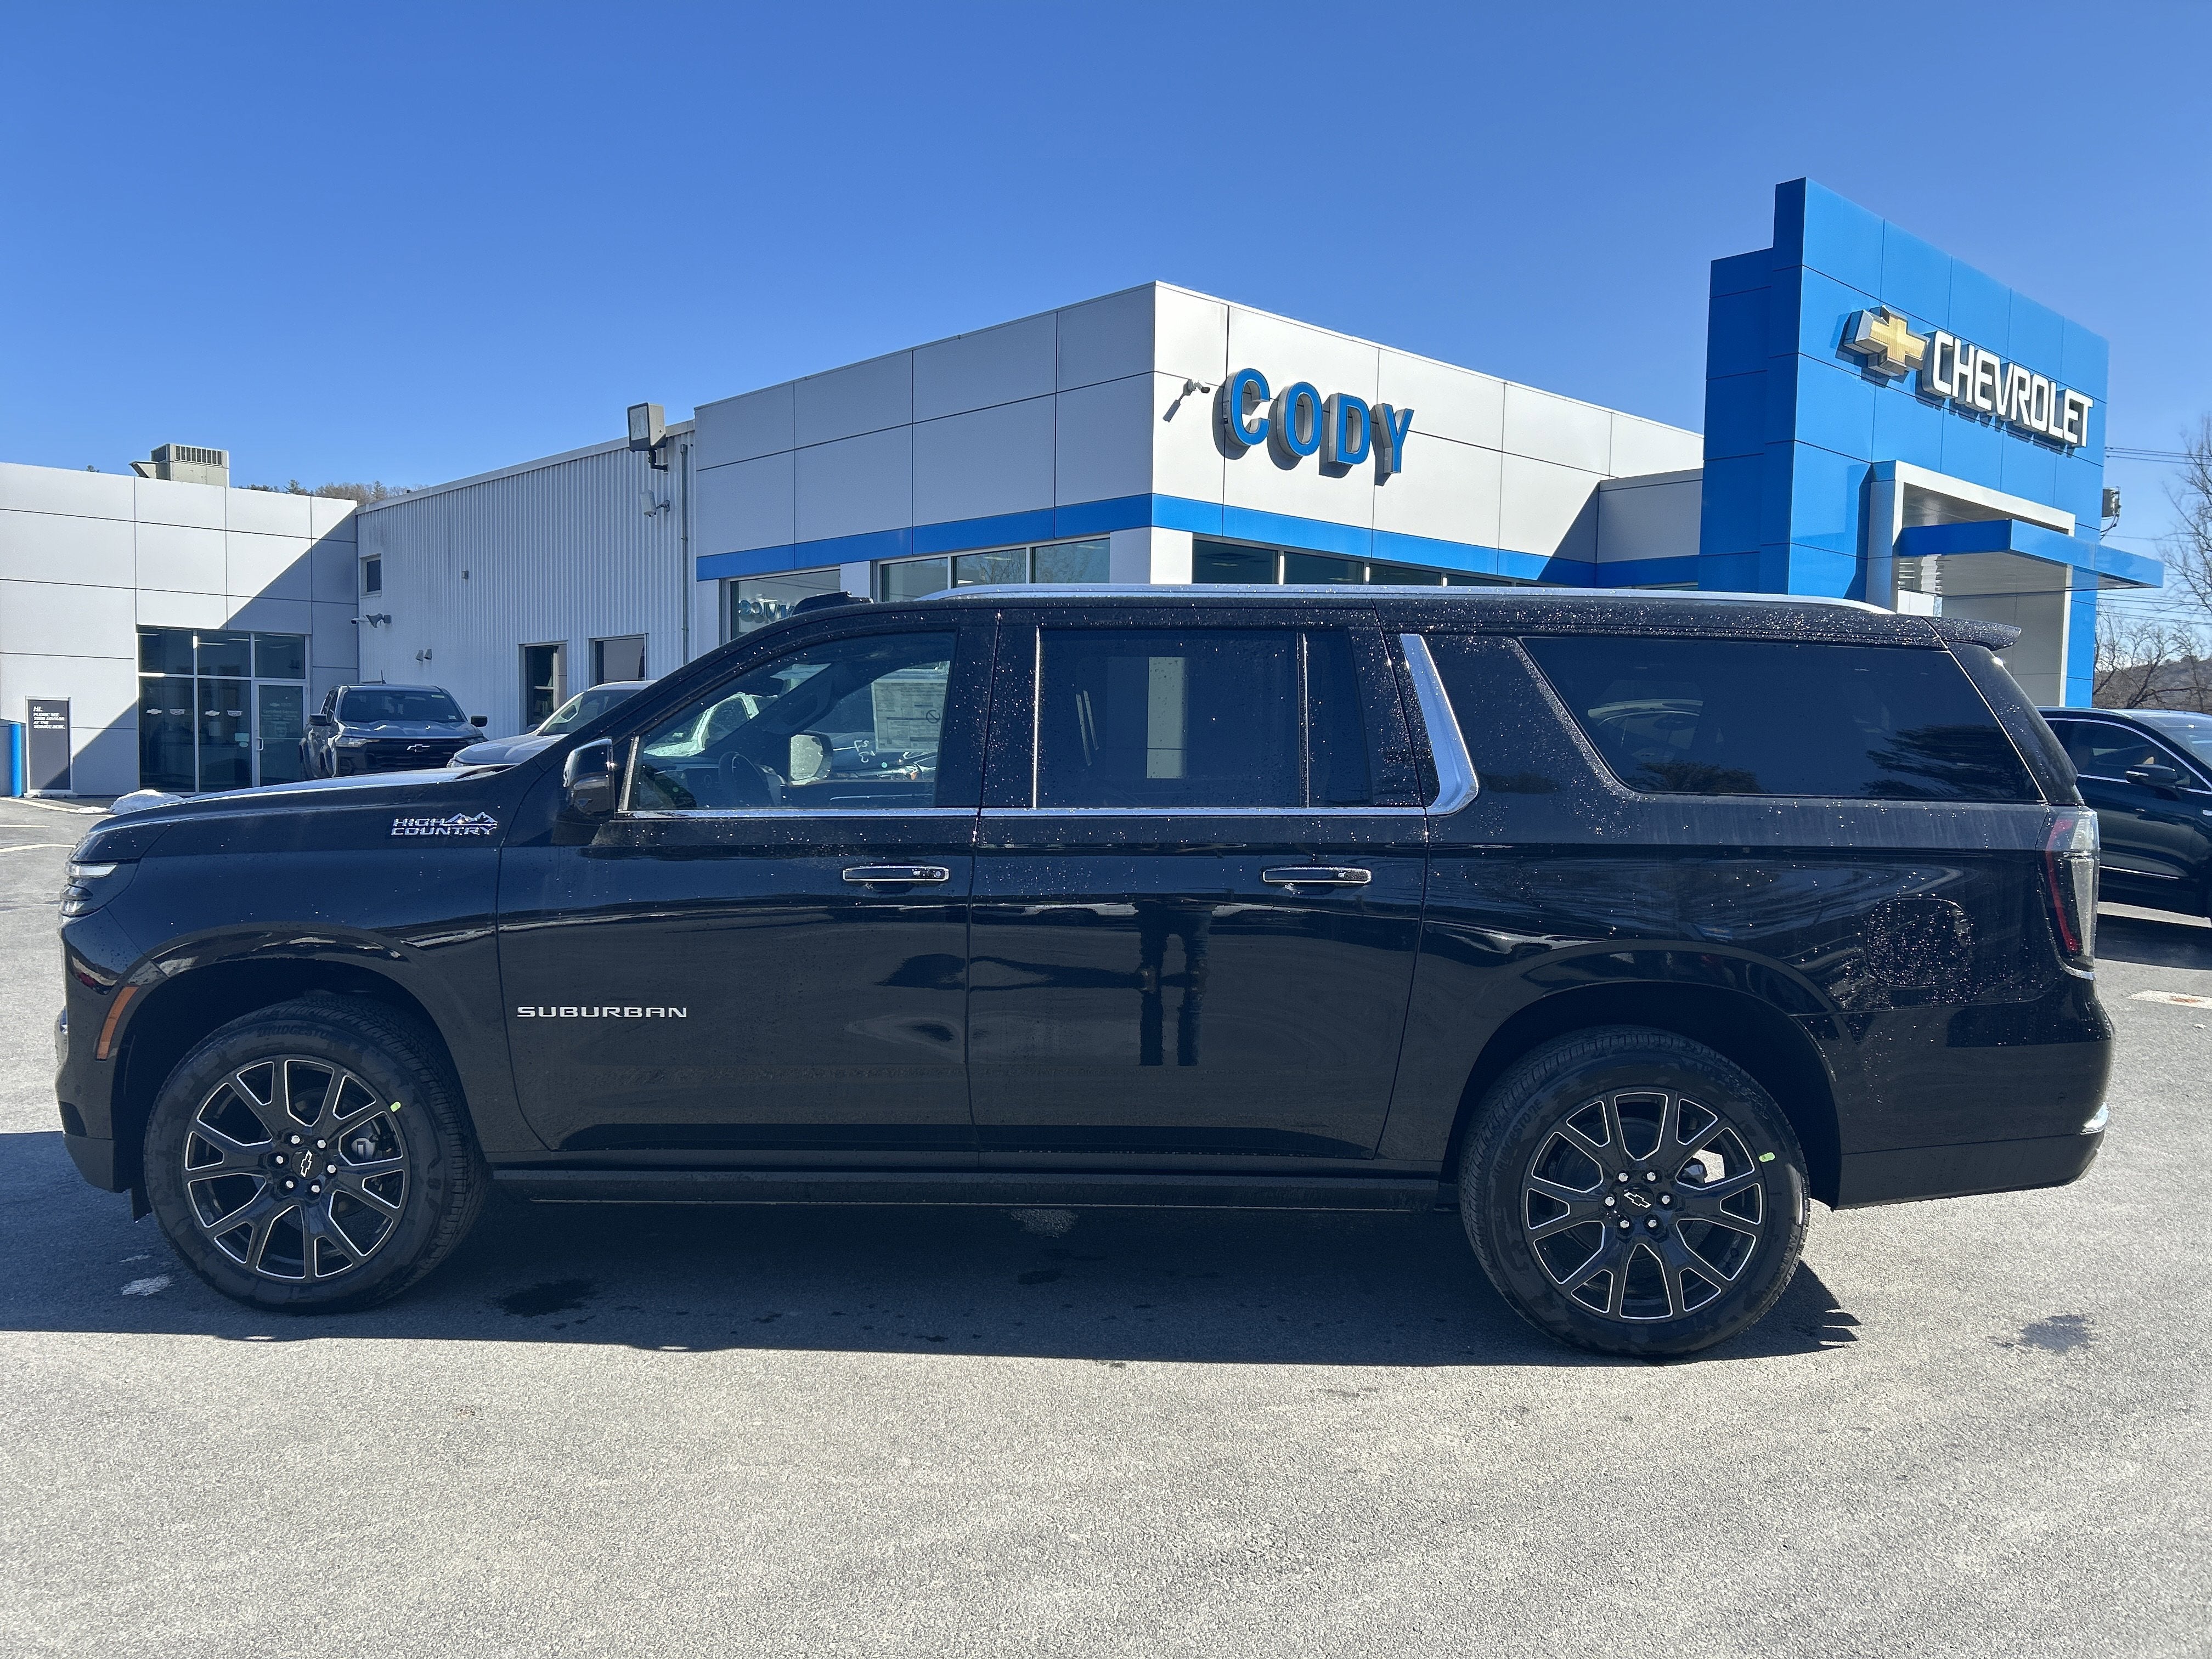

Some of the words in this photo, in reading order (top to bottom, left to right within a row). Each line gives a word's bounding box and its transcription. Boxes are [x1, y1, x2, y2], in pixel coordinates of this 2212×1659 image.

[1925, 330, 2094, 448] CHEVROLET
[1224, 368, 1415, 474] CODY
[392, 818, 445, 827] HIGH
[391, 827, 497, 836] COUNTRY
[517, 1006, 687, 1018] SUBURBAN
[256, 1024, 342, 1042] BRIDGESTO
